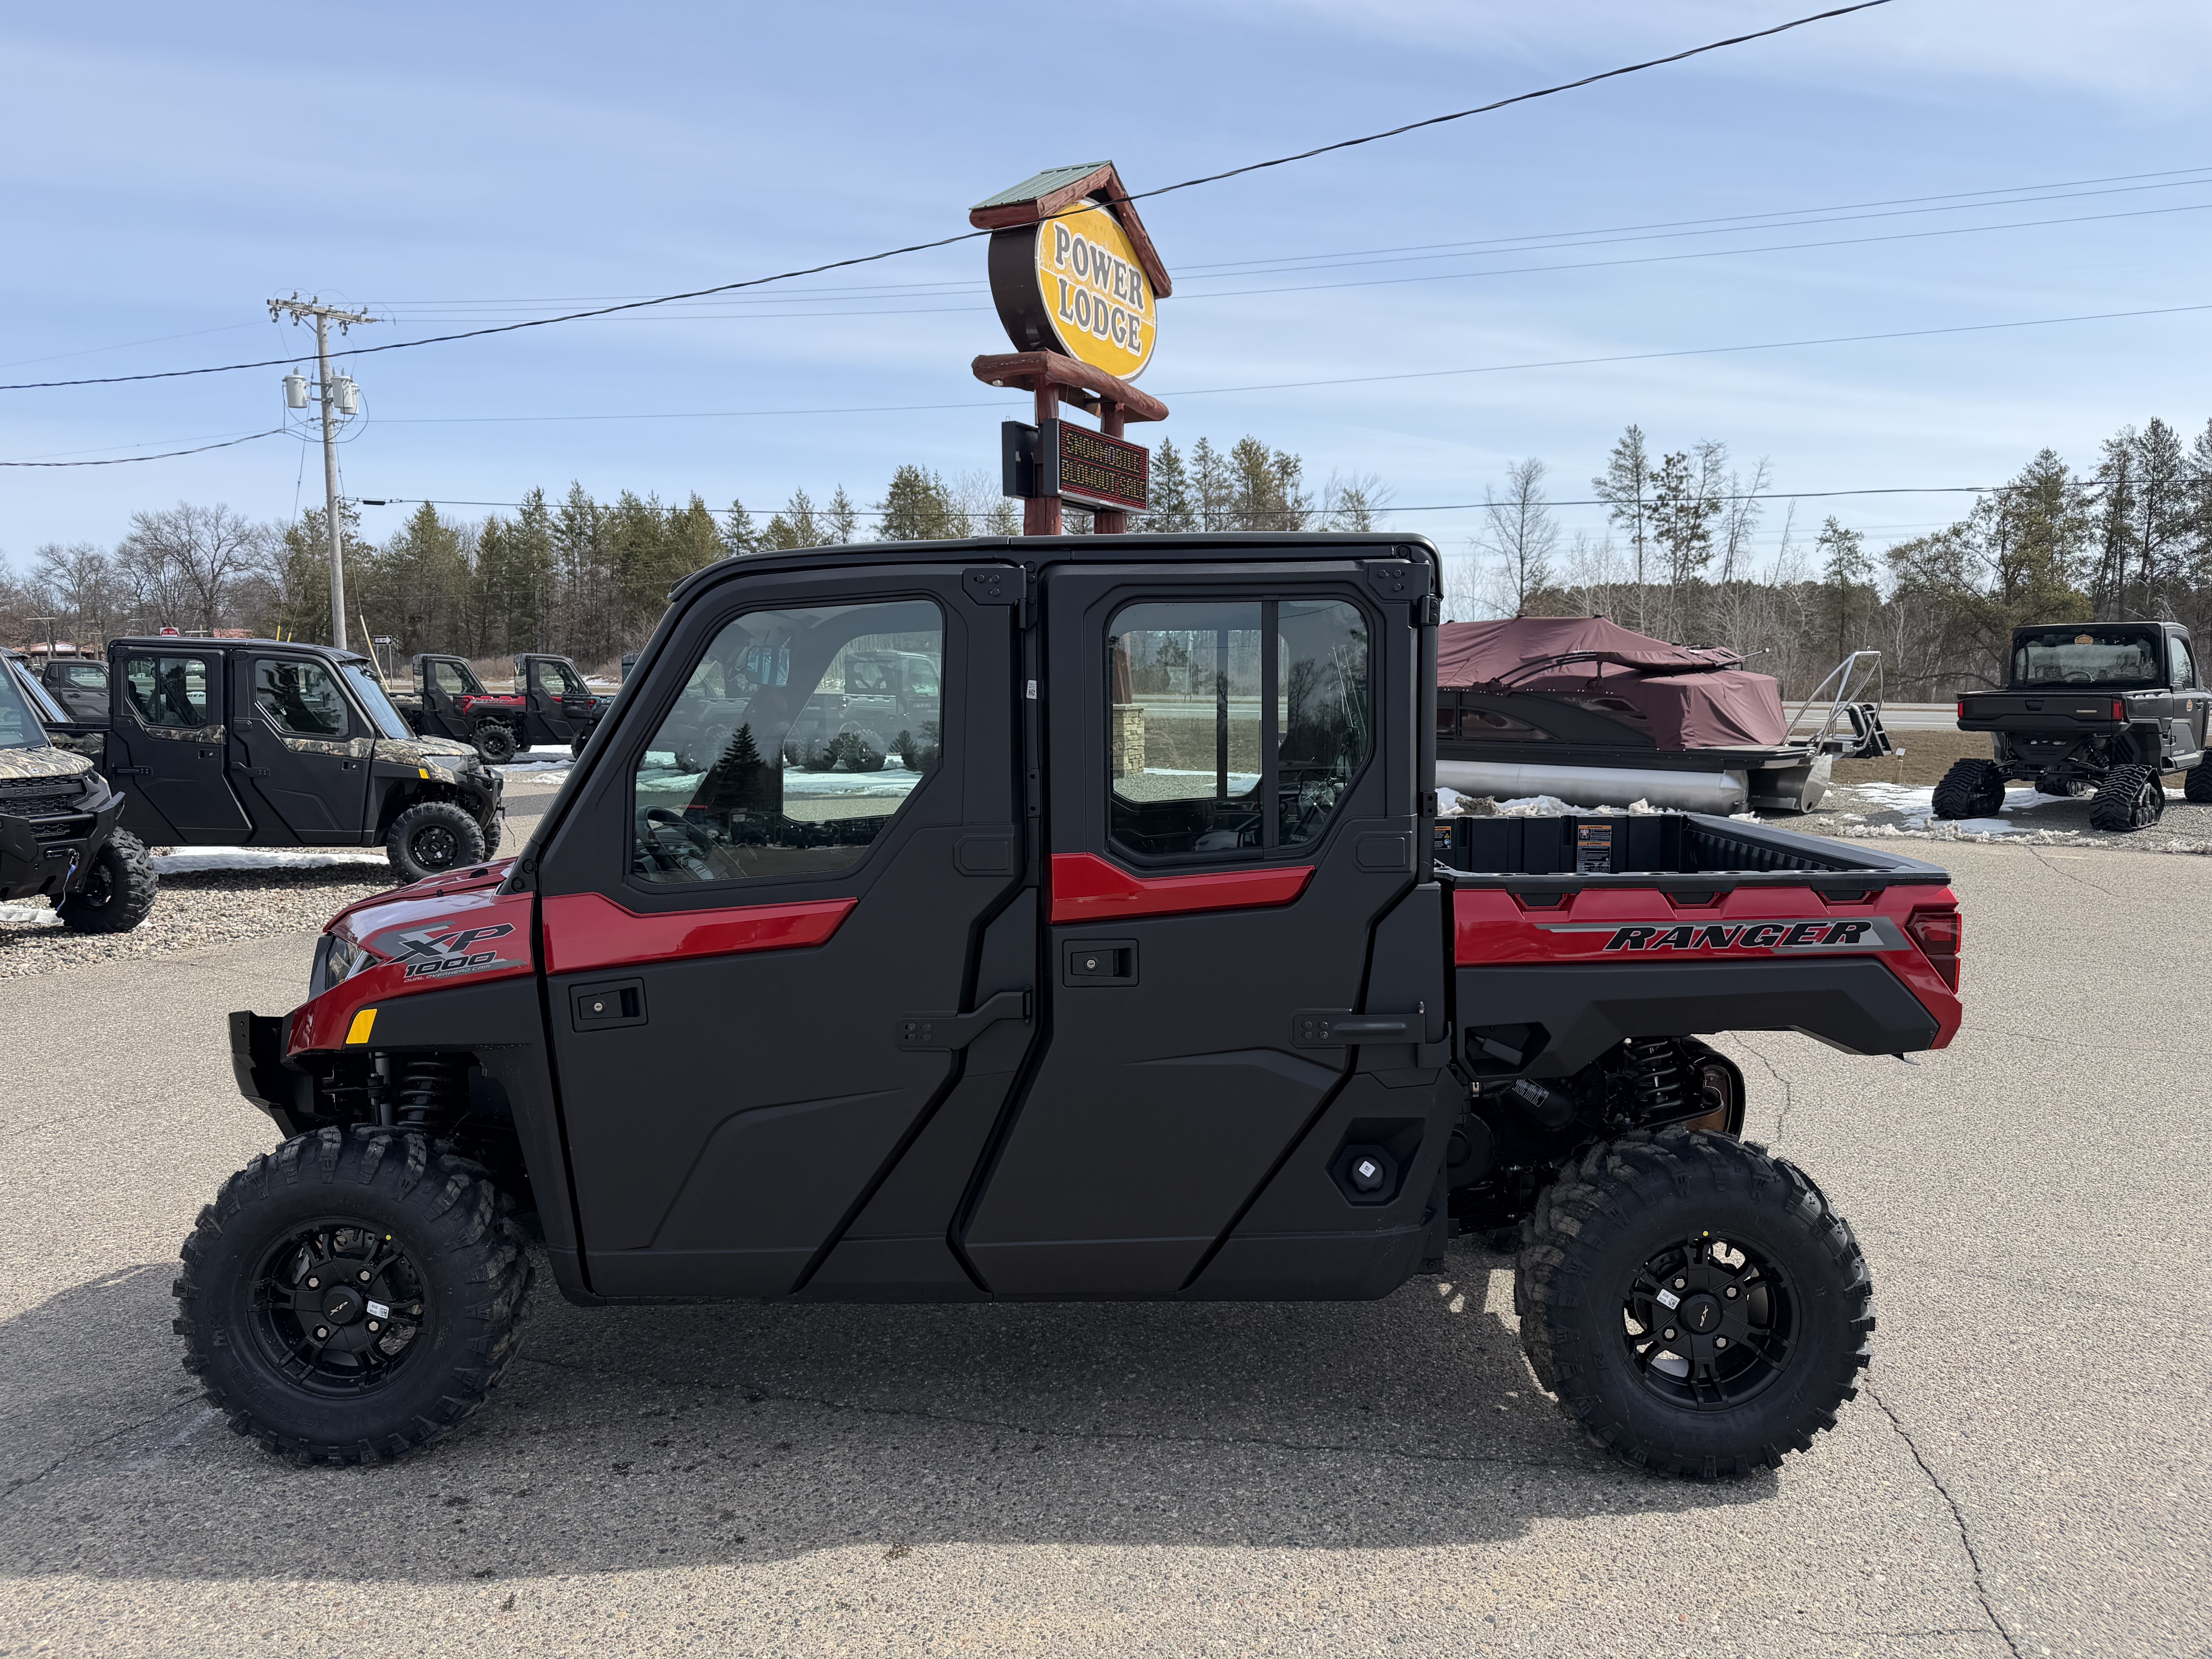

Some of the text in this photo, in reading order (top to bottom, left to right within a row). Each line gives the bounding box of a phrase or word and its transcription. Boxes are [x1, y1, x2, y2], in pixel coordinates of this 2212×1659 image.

[1054, 223, 1144, 311] POWER
[1059, 277, 1141, 353] LODGE
[1066, 433, 1140, 473] SNOWMOBILE
[1061, 460, 1146, 500] BLOWOUT SALE
[380, 923, 516, 967] XP
[1602, 921, 1872, 951] RANGER
[404, 950, 497, 978] 1000
[426, 967, 471, 979] OVERHEAD
[330, 1301, 348, 1316] XP
